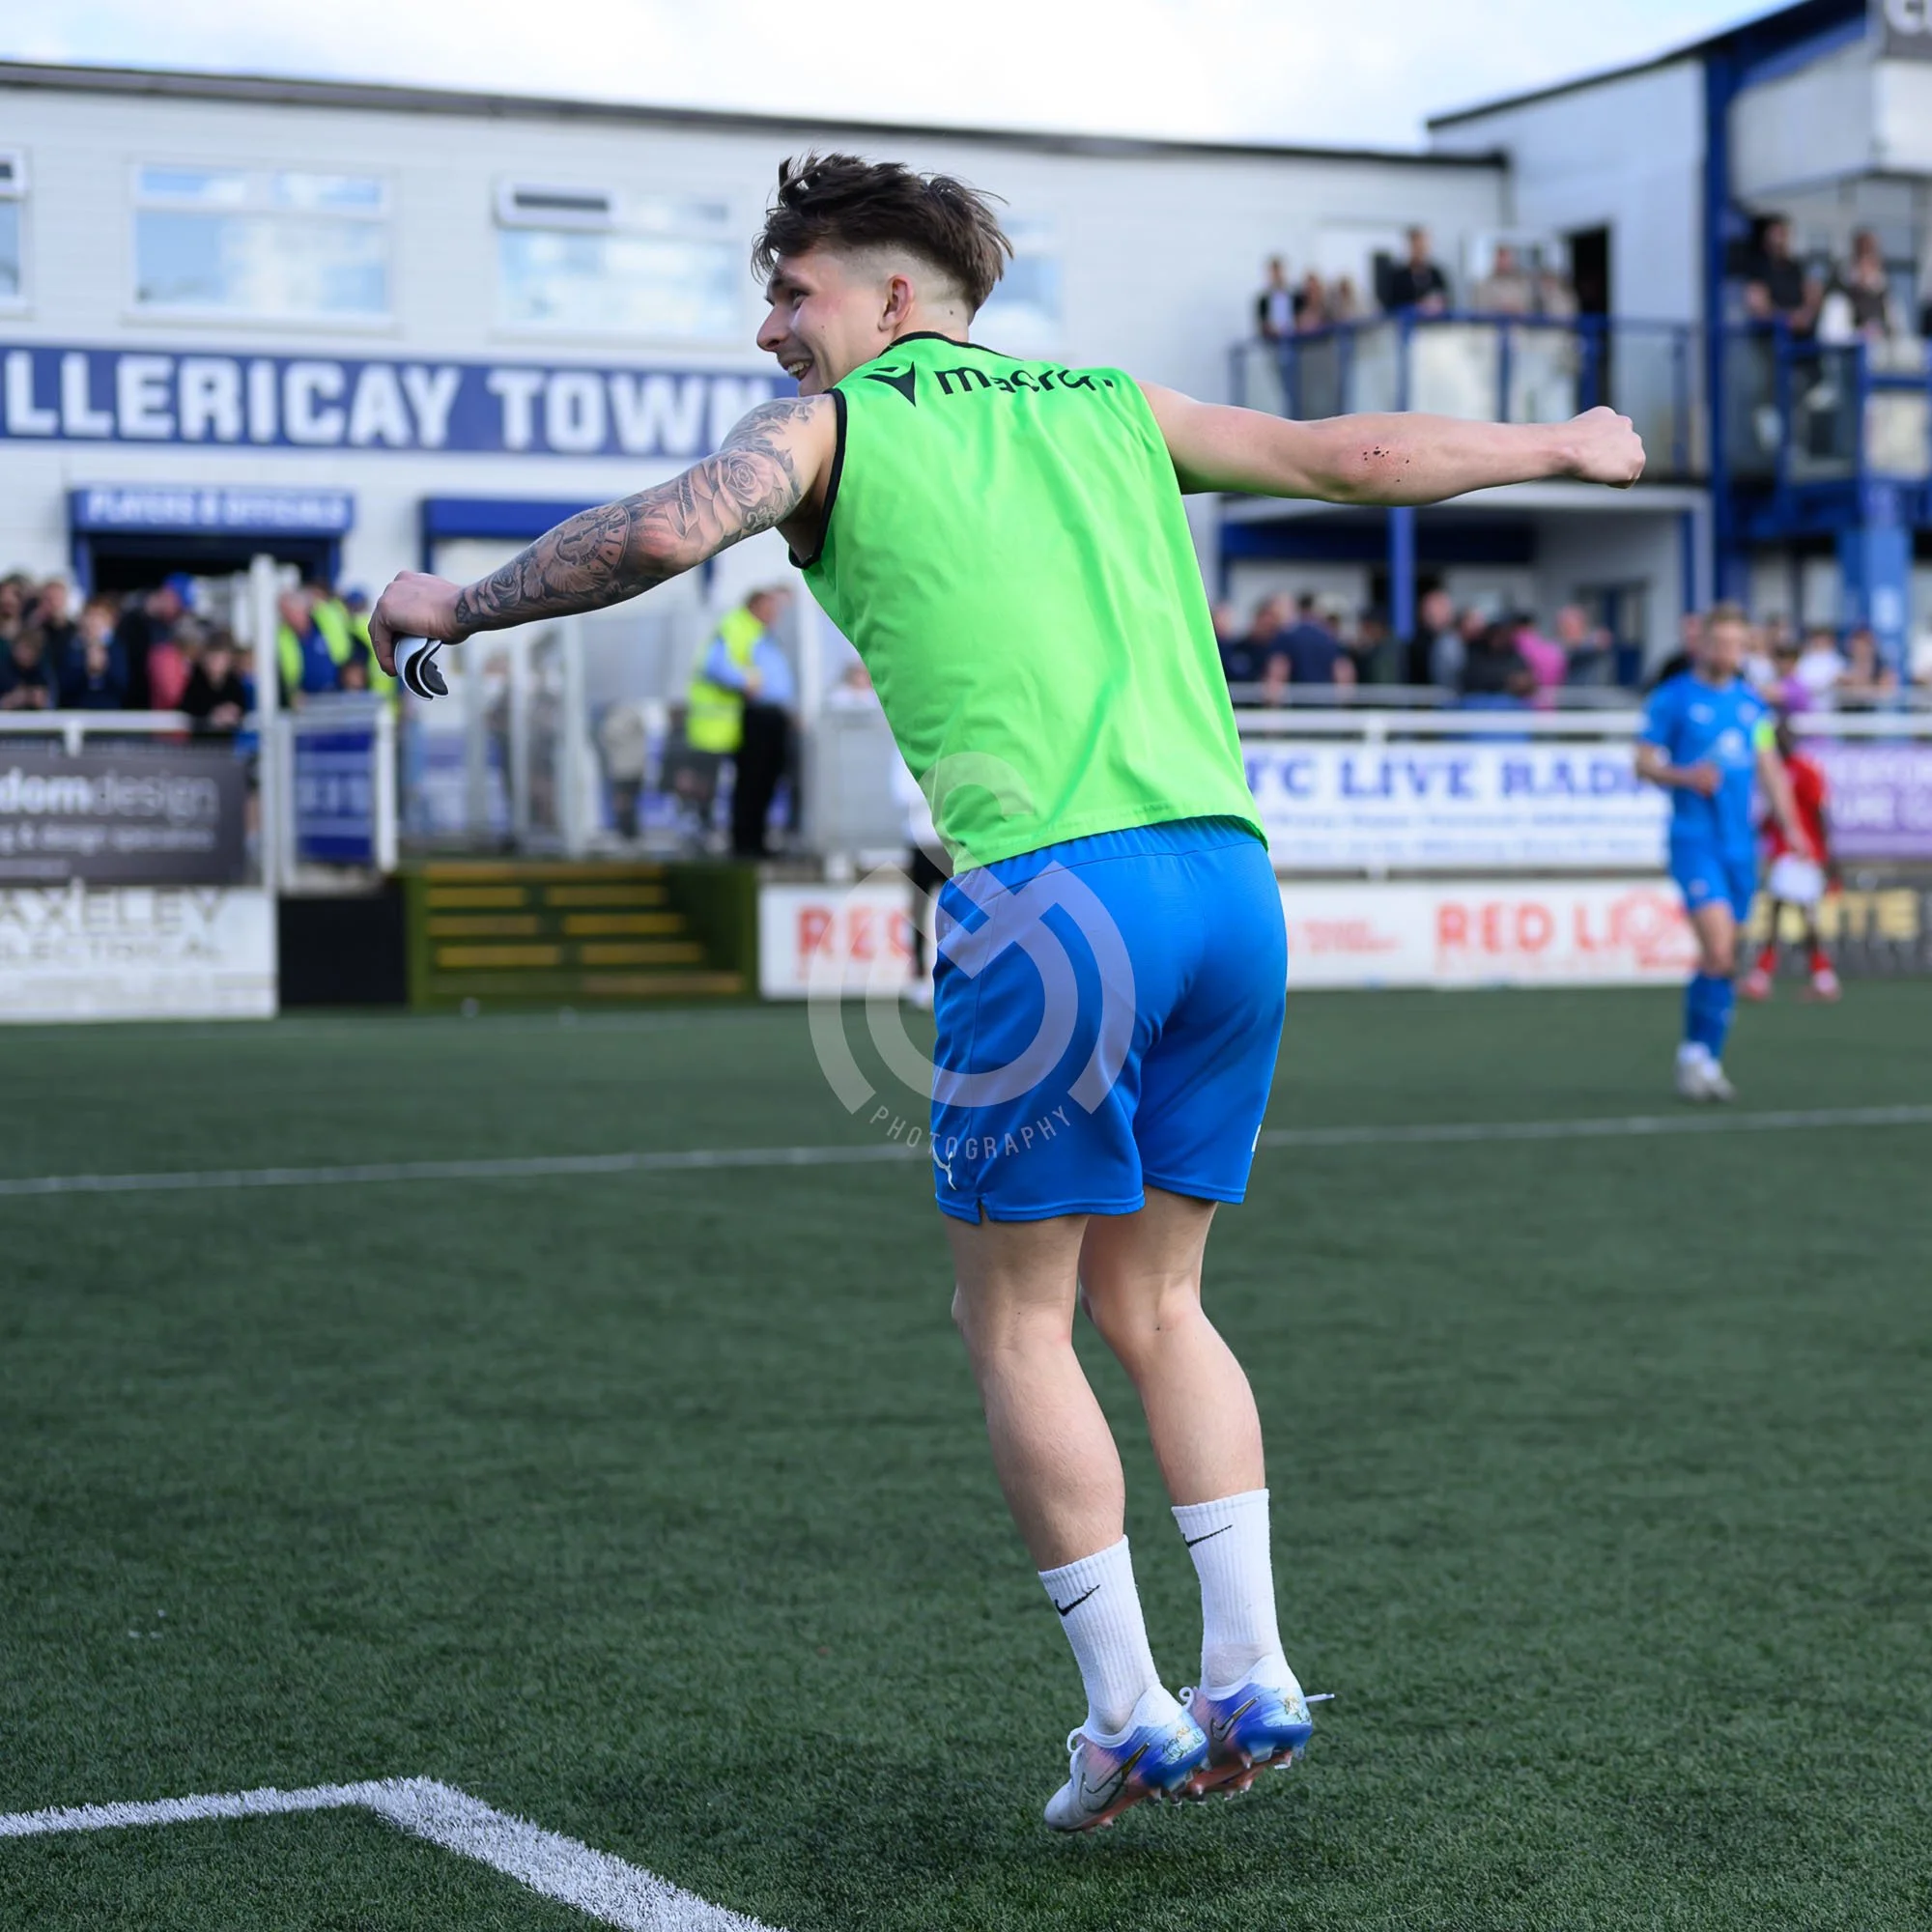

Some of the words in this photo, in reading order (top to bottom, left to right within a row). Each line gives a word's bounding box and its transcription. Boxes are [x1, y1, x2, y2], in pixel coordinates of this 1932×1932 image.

[5, 351, 462, 448] LLERICAY
[1340, 754, 1476, 800] LIVE
[1435, 901, 1555, 953] RED
